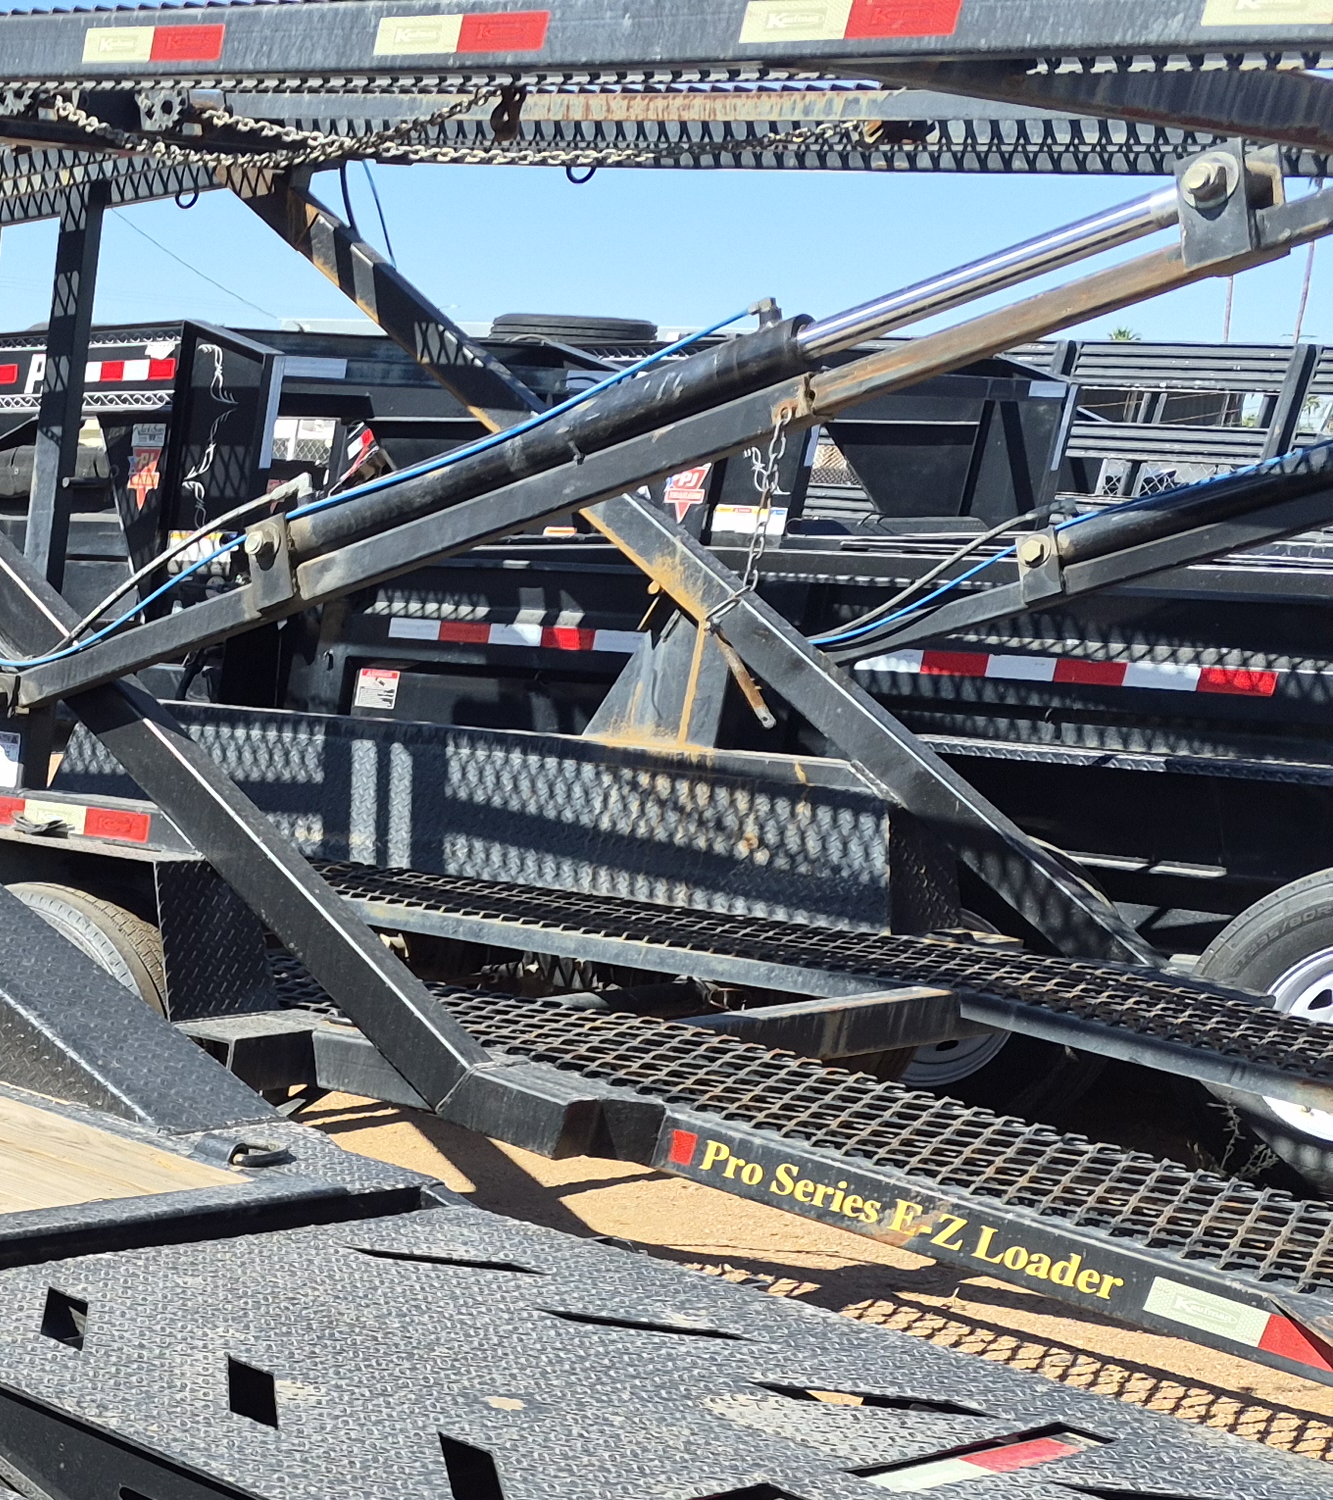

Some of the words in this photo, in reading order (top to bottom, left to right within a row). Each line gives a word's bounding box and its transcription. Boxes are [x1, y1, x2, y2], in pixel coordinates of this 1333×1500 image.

[24, 354, 46, 394] P
[679, 472, 699, 487] PJ
[698, 1139, 764, 1186] Pro
[769, 1163, 882, 1224] Series
[887, 1198, 969, 1251] E-Z
[971, 1225, 1125, 1300] Loader
[1173, 1295, 1237, 1323] Kaufman
